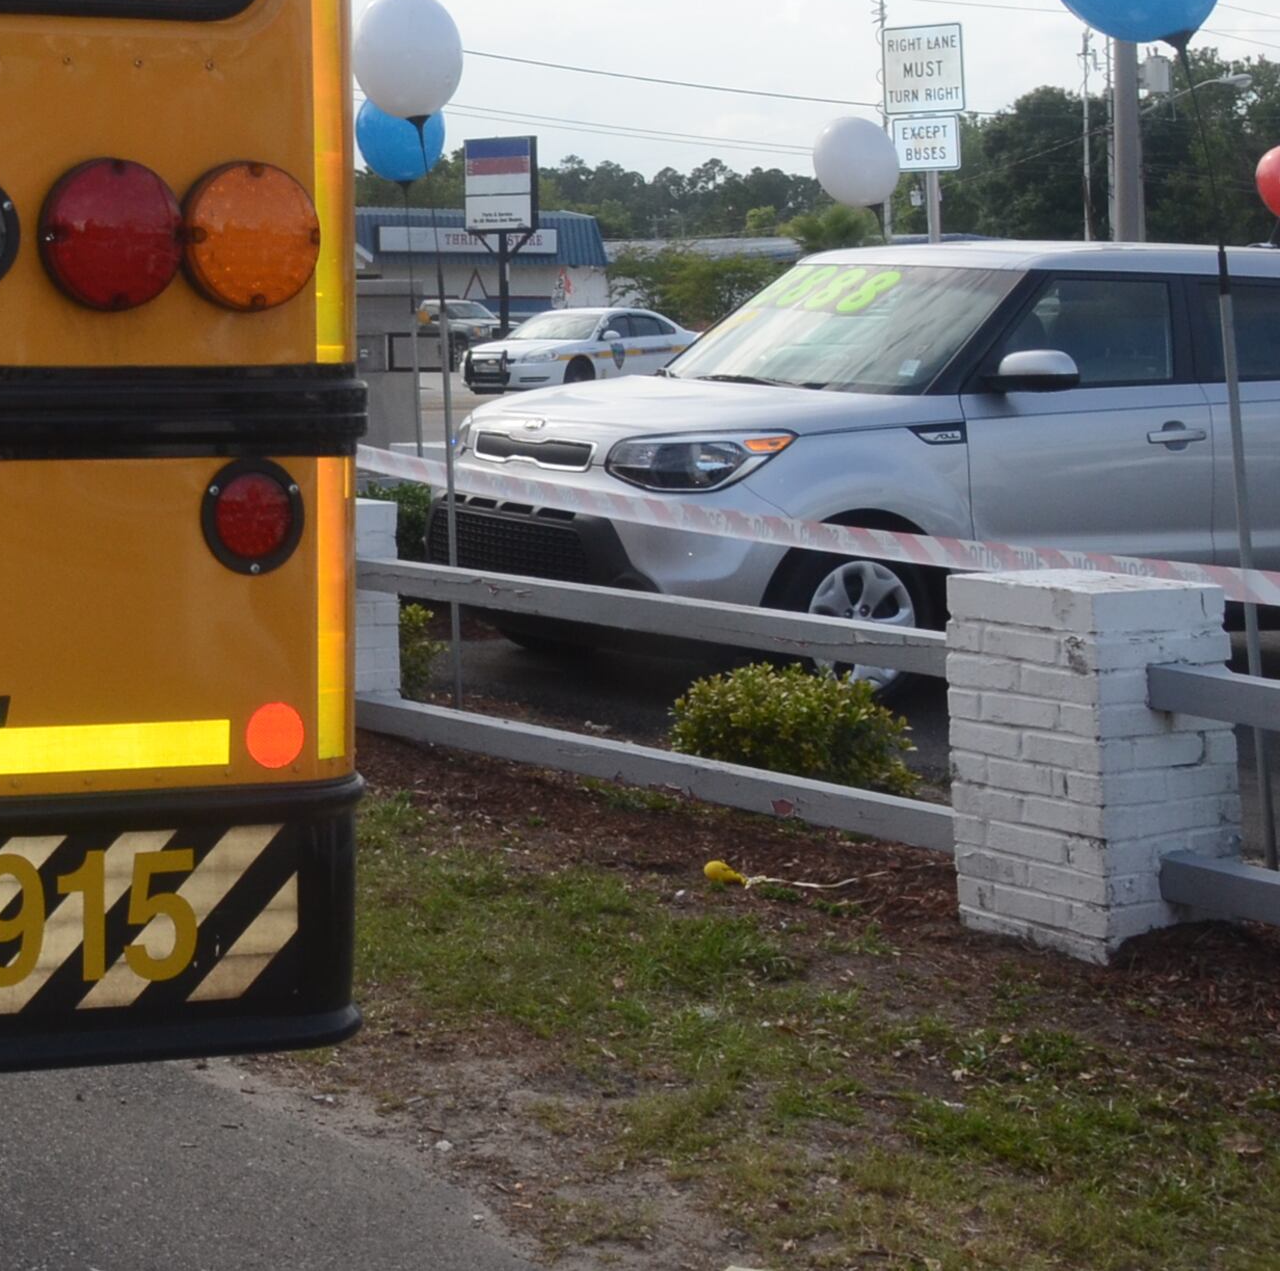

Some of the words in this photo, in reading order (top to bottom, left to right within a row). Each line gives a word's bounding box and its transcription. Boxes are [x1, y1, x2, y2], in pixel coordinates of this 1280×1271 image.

[887, 37, 922, 53] RIGHT
[926, 34, 957, 50] LANE
[903, 60, 943, 78] MUST
[888, 89, 919, 104] TURN
[924, 86, 960, 102] RIGHT
[902, 125, 947, 140] EXCEPT
[906, 146, 946, 161] BUSES
